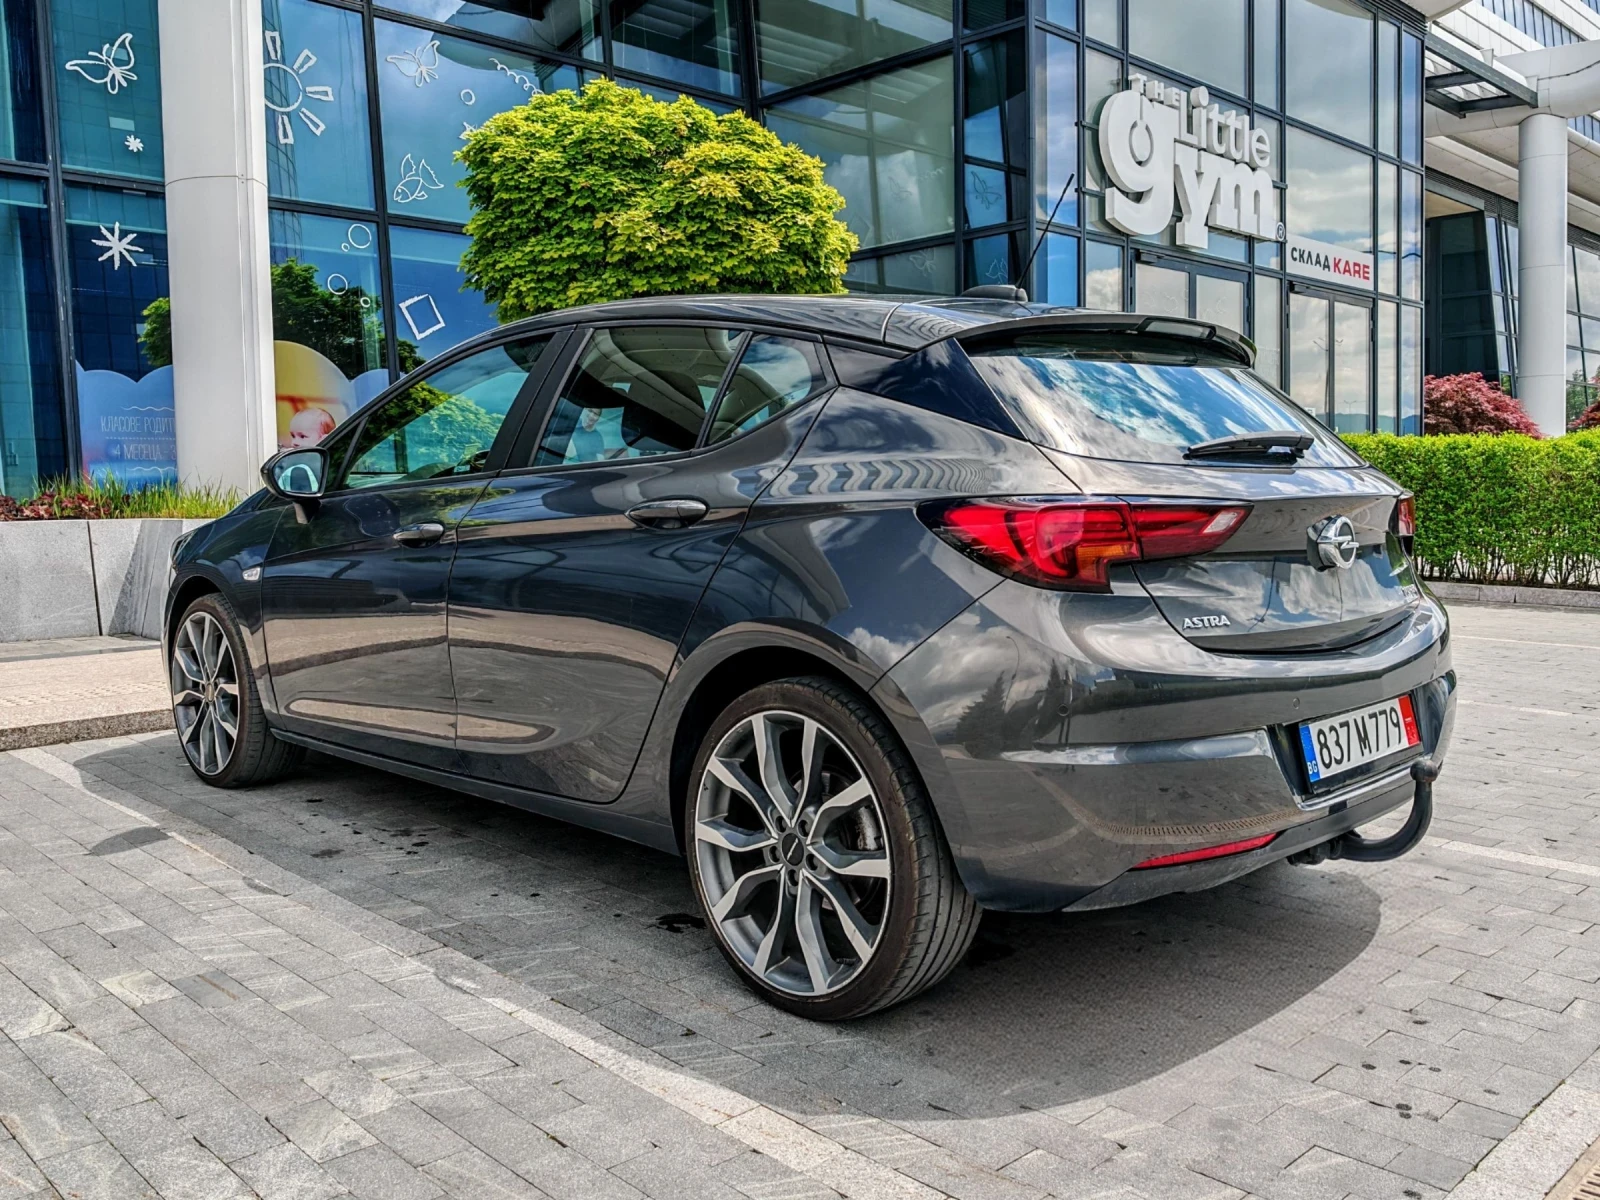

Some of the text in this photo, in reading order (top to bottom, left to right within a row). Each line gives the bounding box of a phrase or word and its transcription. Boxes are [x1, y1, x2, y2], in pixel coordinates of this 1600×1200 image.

[1128, 73, 1180, 107] THE
[1179, 86, 1270, 168] Little
[1099, 90, 1276, 249] gym
[1333, 256, 1370, 281] KARE
[101, 415, 176, 435] КЛАСОВЕ РОДИТ
[1182, 614, 1231, 630] ASTRA
[1307, 760, 1318, 775] BG
